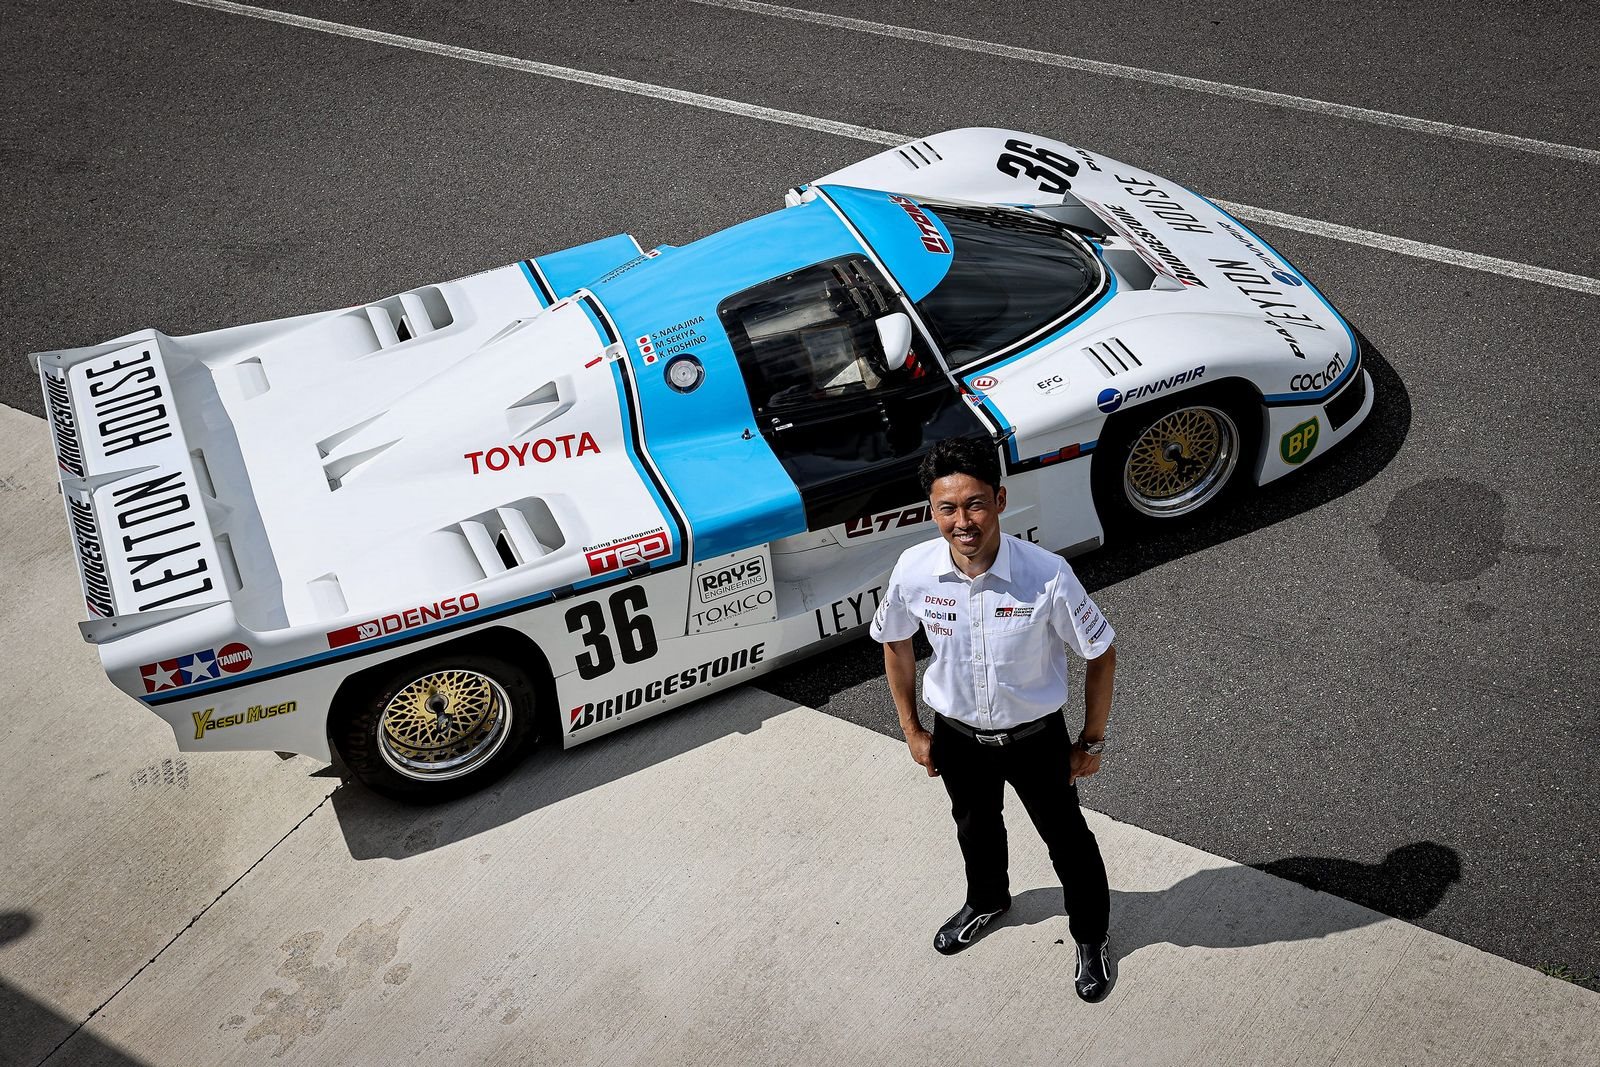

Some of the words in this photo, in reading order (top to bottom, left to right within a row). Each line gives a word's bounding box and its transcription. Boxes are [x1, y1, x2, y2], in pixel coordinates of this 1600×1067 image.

[997, 139, 1080, 195] 36
[1114, 173, 1214, 234] HOUSE
[1103, 203, 1210, 289] BRIDGESTONE
[1208, 258, 1326, 331] LEYTON
[652, 315, 705, 340] S.NAKAJIMA
[655, 329, 696, 349] M.SEKIYA
[659, 335, 707, 358] K.HOSHINO
[1264, 320, 1306, 360] PIAA
[1037, 375, 1063, 390] EFG
[1123, 365, 1206, 403] FINNAIR
[1290, 352, 1345, 392] COCKPIT
[85, 350, 172, 457] HOUSE
[44, 371, 84, 478] BRIDGESTONE
[1287, 424, 1316, 458] BP
[464, 431, 601, 475] TOYOTA
[68, 495, 116, 618] BRIDGESTONE
[112, 471, 213, 612] LEYTON
[582, 542, 611, 553] Racing
[612, 526, 664, 545] Development
[590, 536, 665, 569] TRD
[702, 560, 761, 592] RAYS
[704, 575, 763, 600] ENGINEERING
[381, 592, 480, 636] DENSO
[692, 590, 773, 626] TOKICO
[925, 595, 956, 607] DENSO
[925, 609, 947, 620] Mobil
[564, 584, 659, 681] 36
[927, 623, 953, 636] FUJITSU
[217, 649, 252, 667] TAMIYA
[568, 642, 765, 734] BRIDGESTONE
